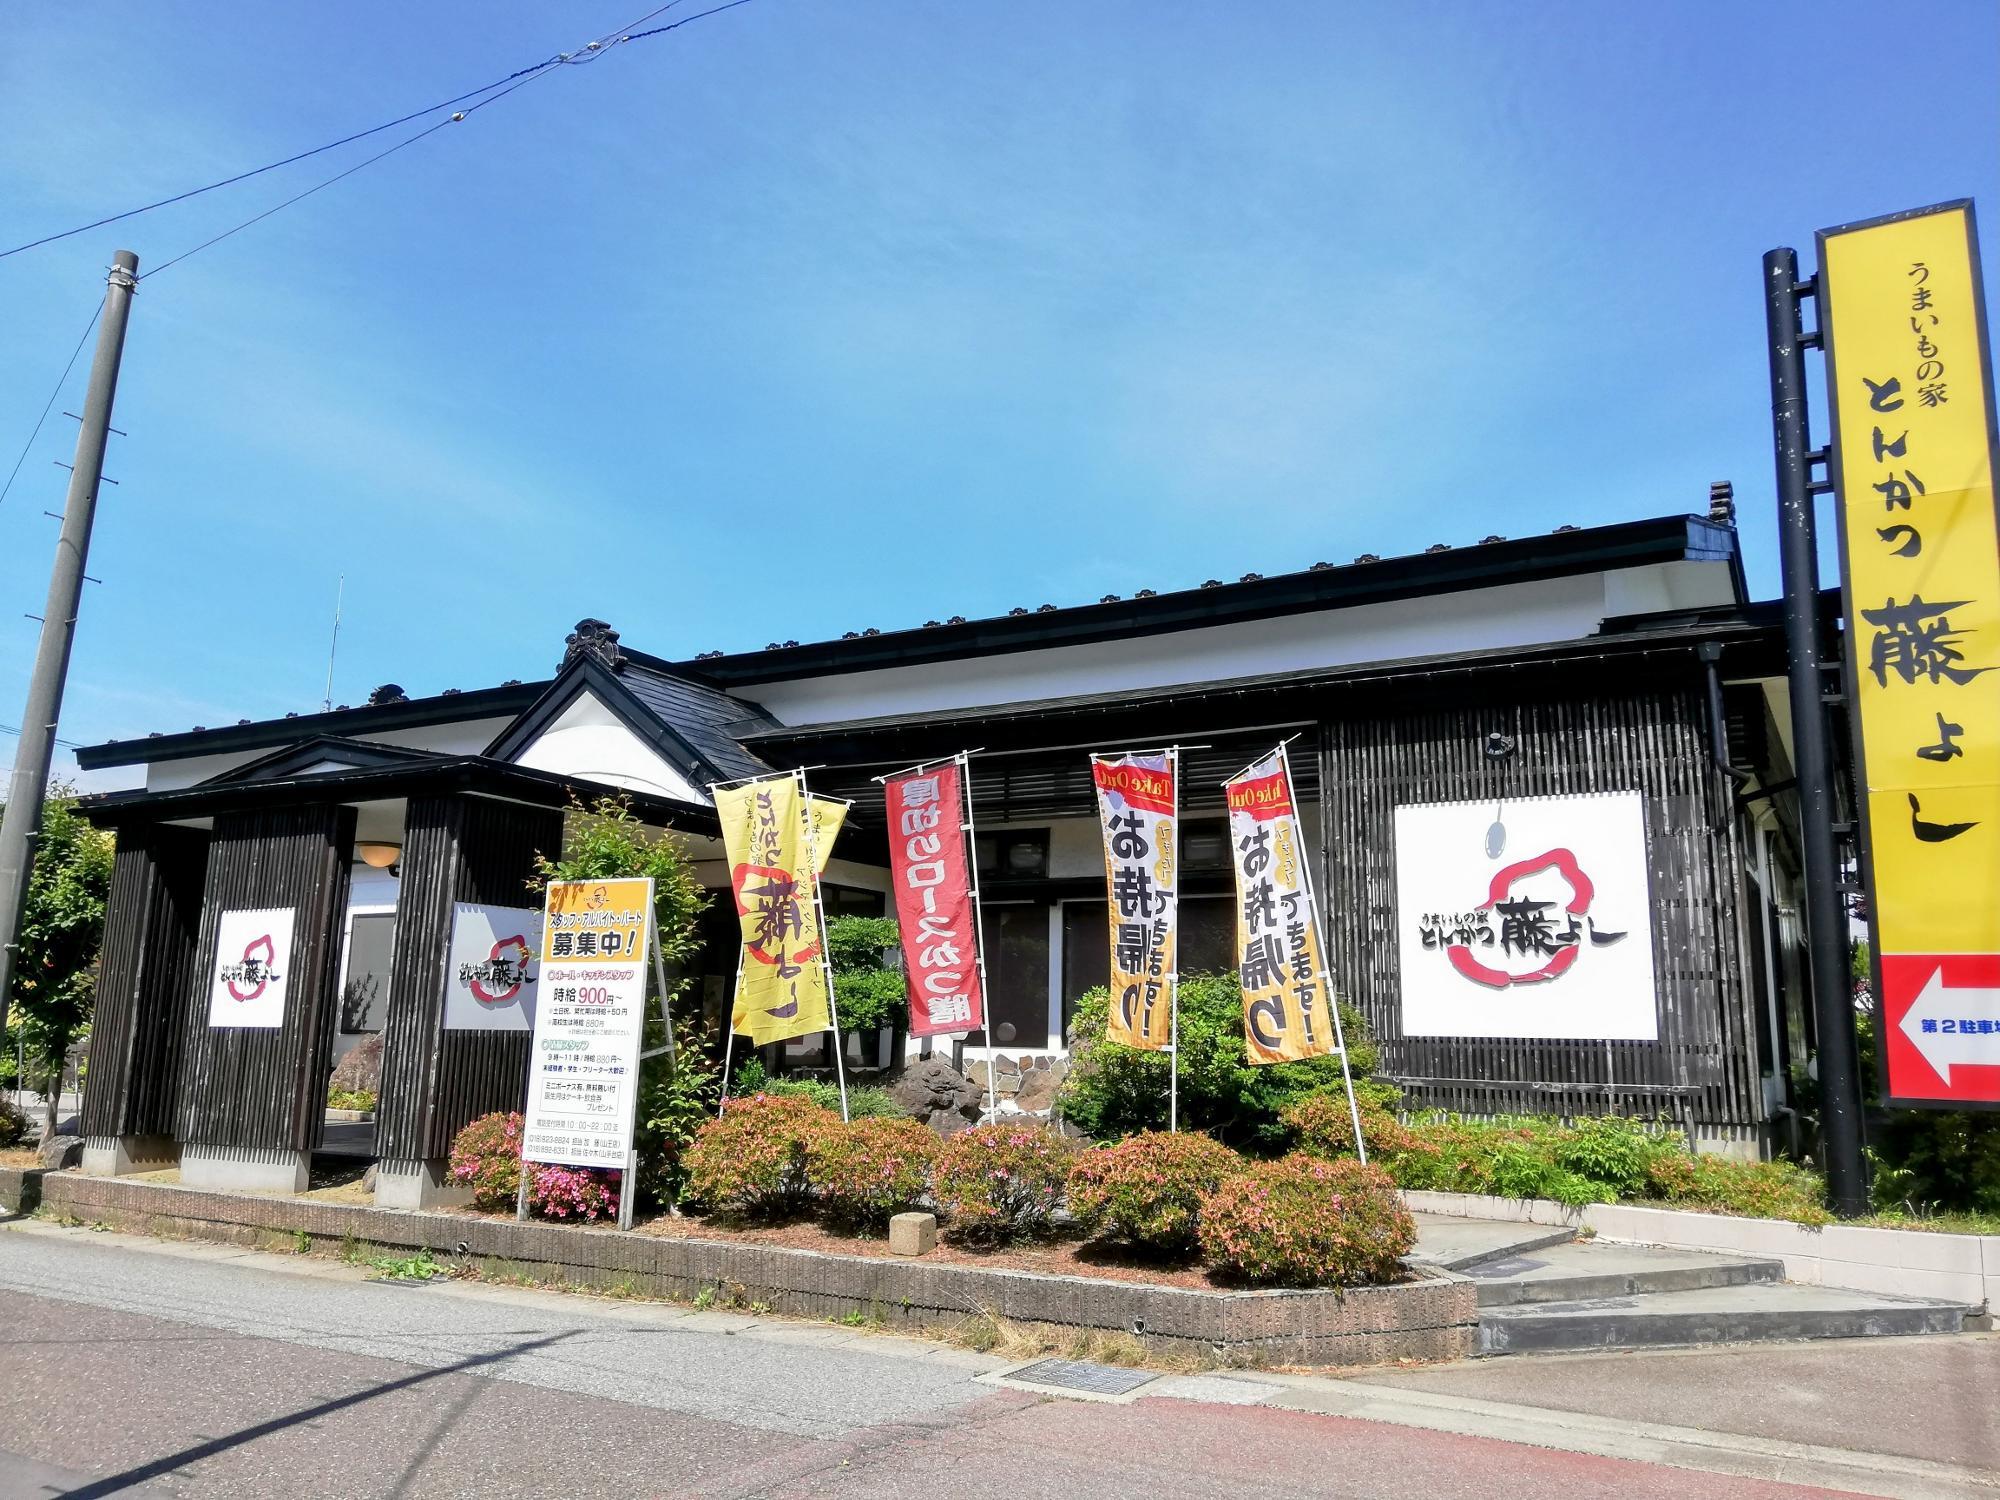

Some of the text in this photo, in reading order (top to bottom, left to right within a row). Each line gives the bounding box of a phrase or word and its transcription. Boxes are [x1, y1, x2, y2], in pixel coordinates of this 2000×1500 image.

[1908, 262, 1949, 408] うまいもの家
[1422, 911, 1489, 925] うまいもの家
[553, 930, 636, 956] 募集中!
[1419, 926, 1494, 947] とんかつ
